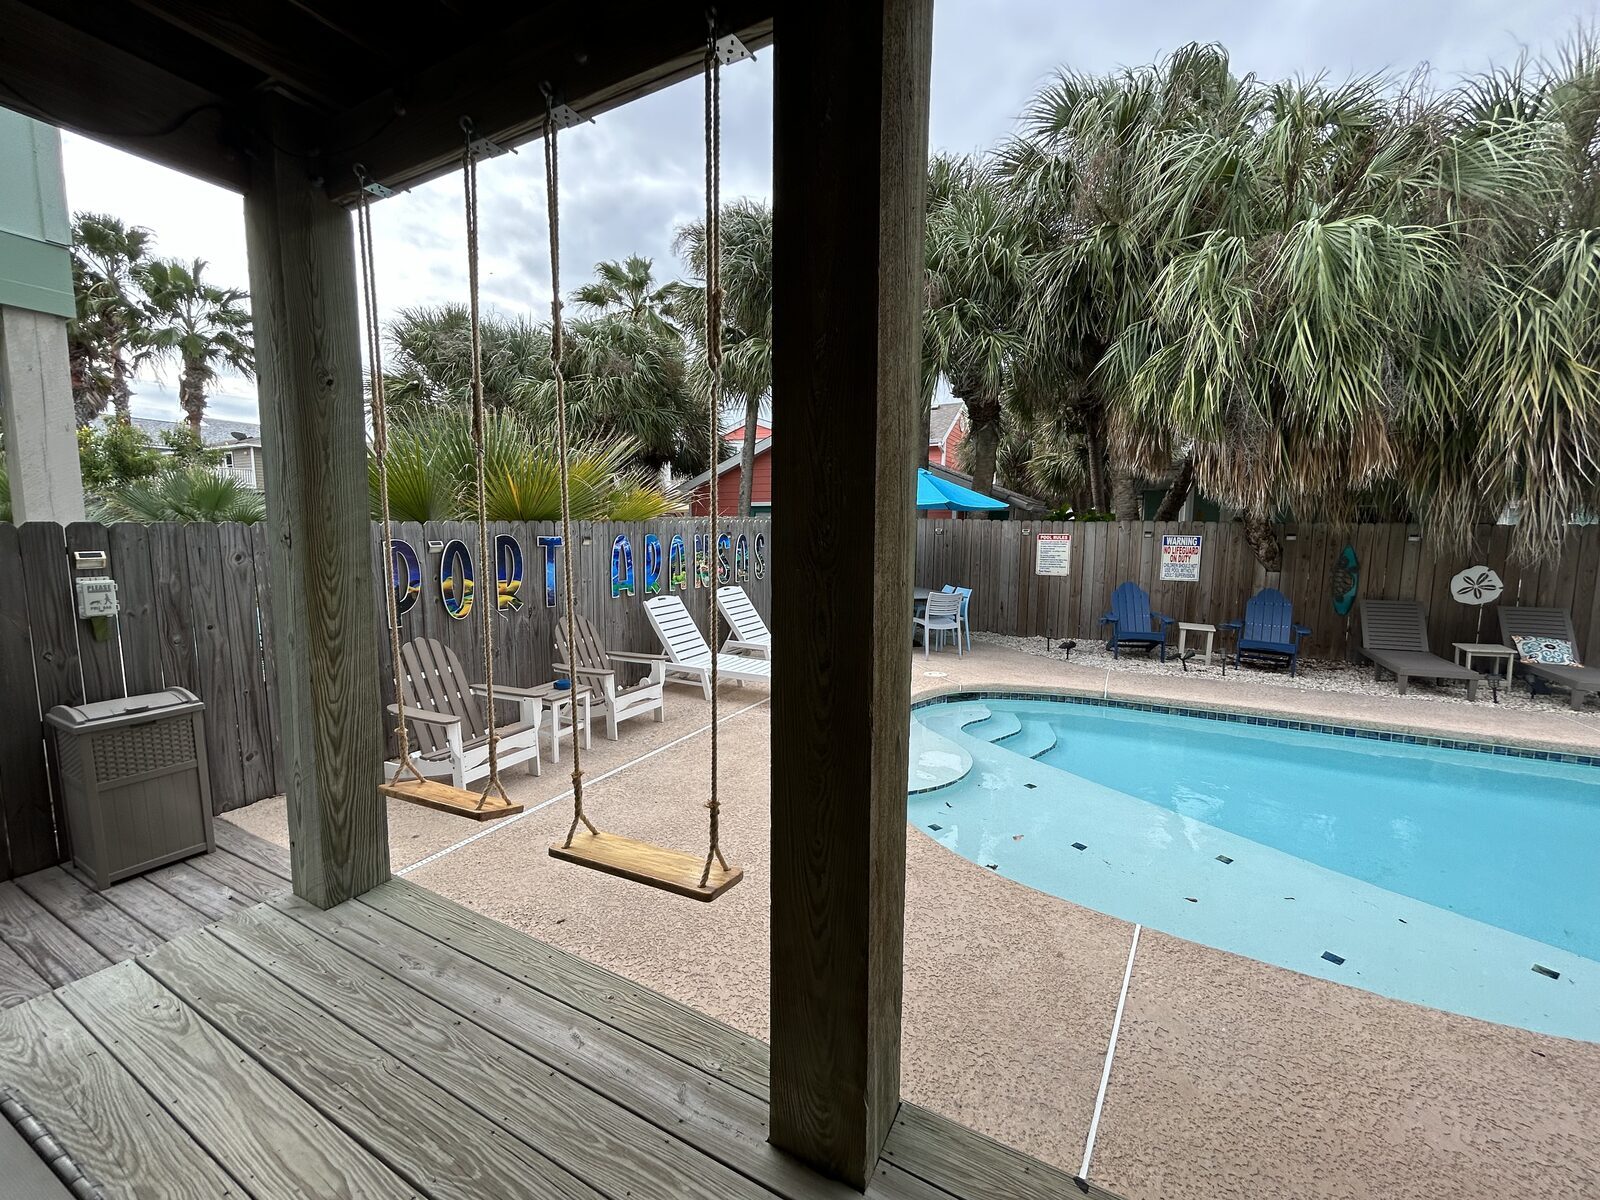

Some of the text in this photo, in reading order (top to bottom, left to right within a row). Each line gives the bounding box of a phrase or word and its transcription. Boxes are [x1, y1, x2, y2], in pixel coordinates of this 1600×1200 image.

[1166, 537, 1198, 546] WARNING
[1172, 547, 1198, 555] LIFEGUARD
[1178, 555, 1192, 563] DUTY
[382, 532, 766, 629] PORT ARANSAS
